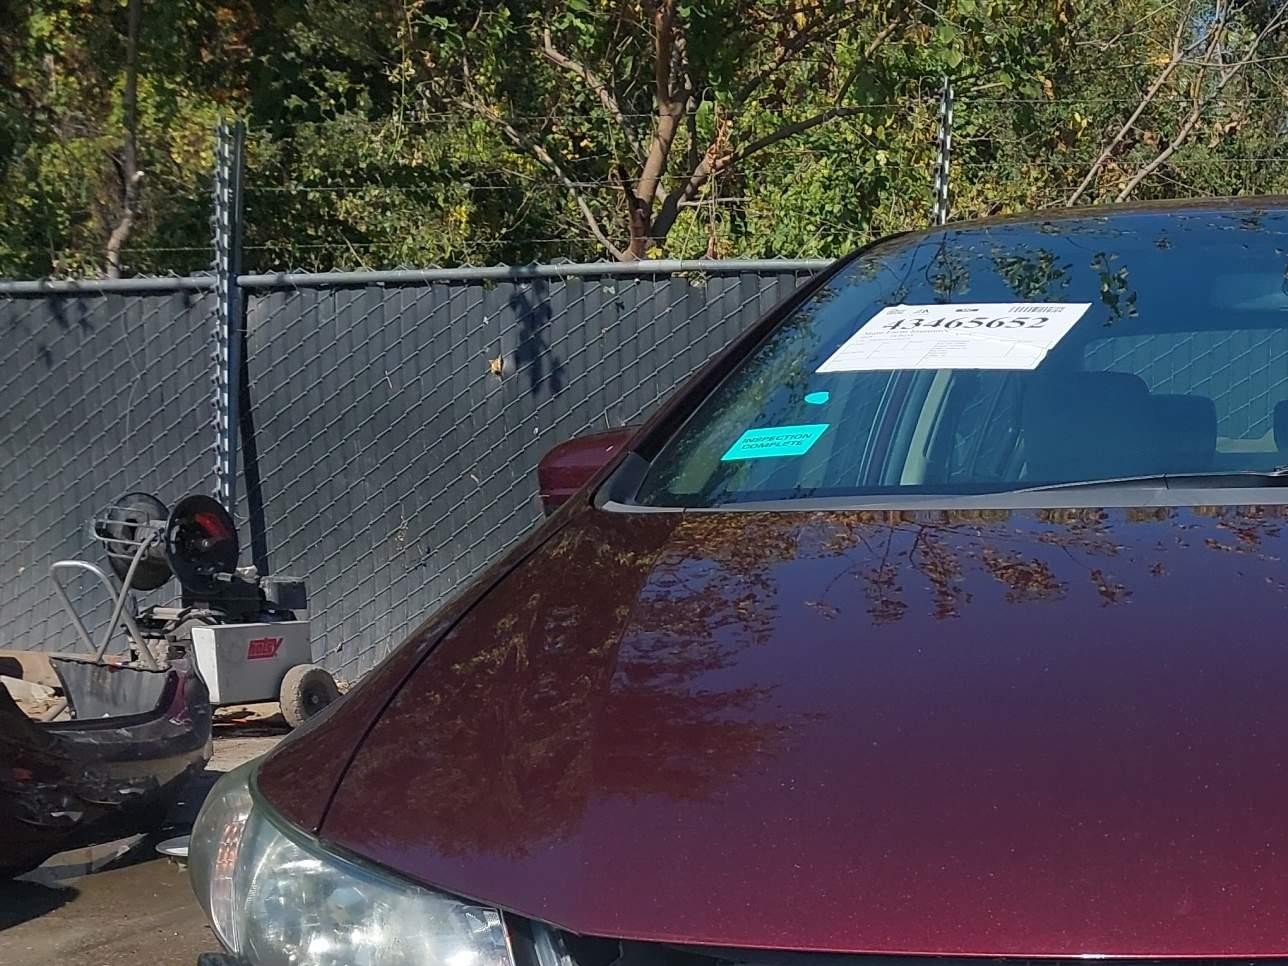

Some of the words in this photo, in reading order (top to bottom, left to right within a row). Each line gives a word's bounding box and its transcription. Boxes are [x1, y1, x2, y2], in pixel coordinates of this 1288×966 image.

[883, 317, 1049, 331] 43465652
[741, 433, 813, 444] INSPECTION
[741, 440, 803, 450] COMPLETE
